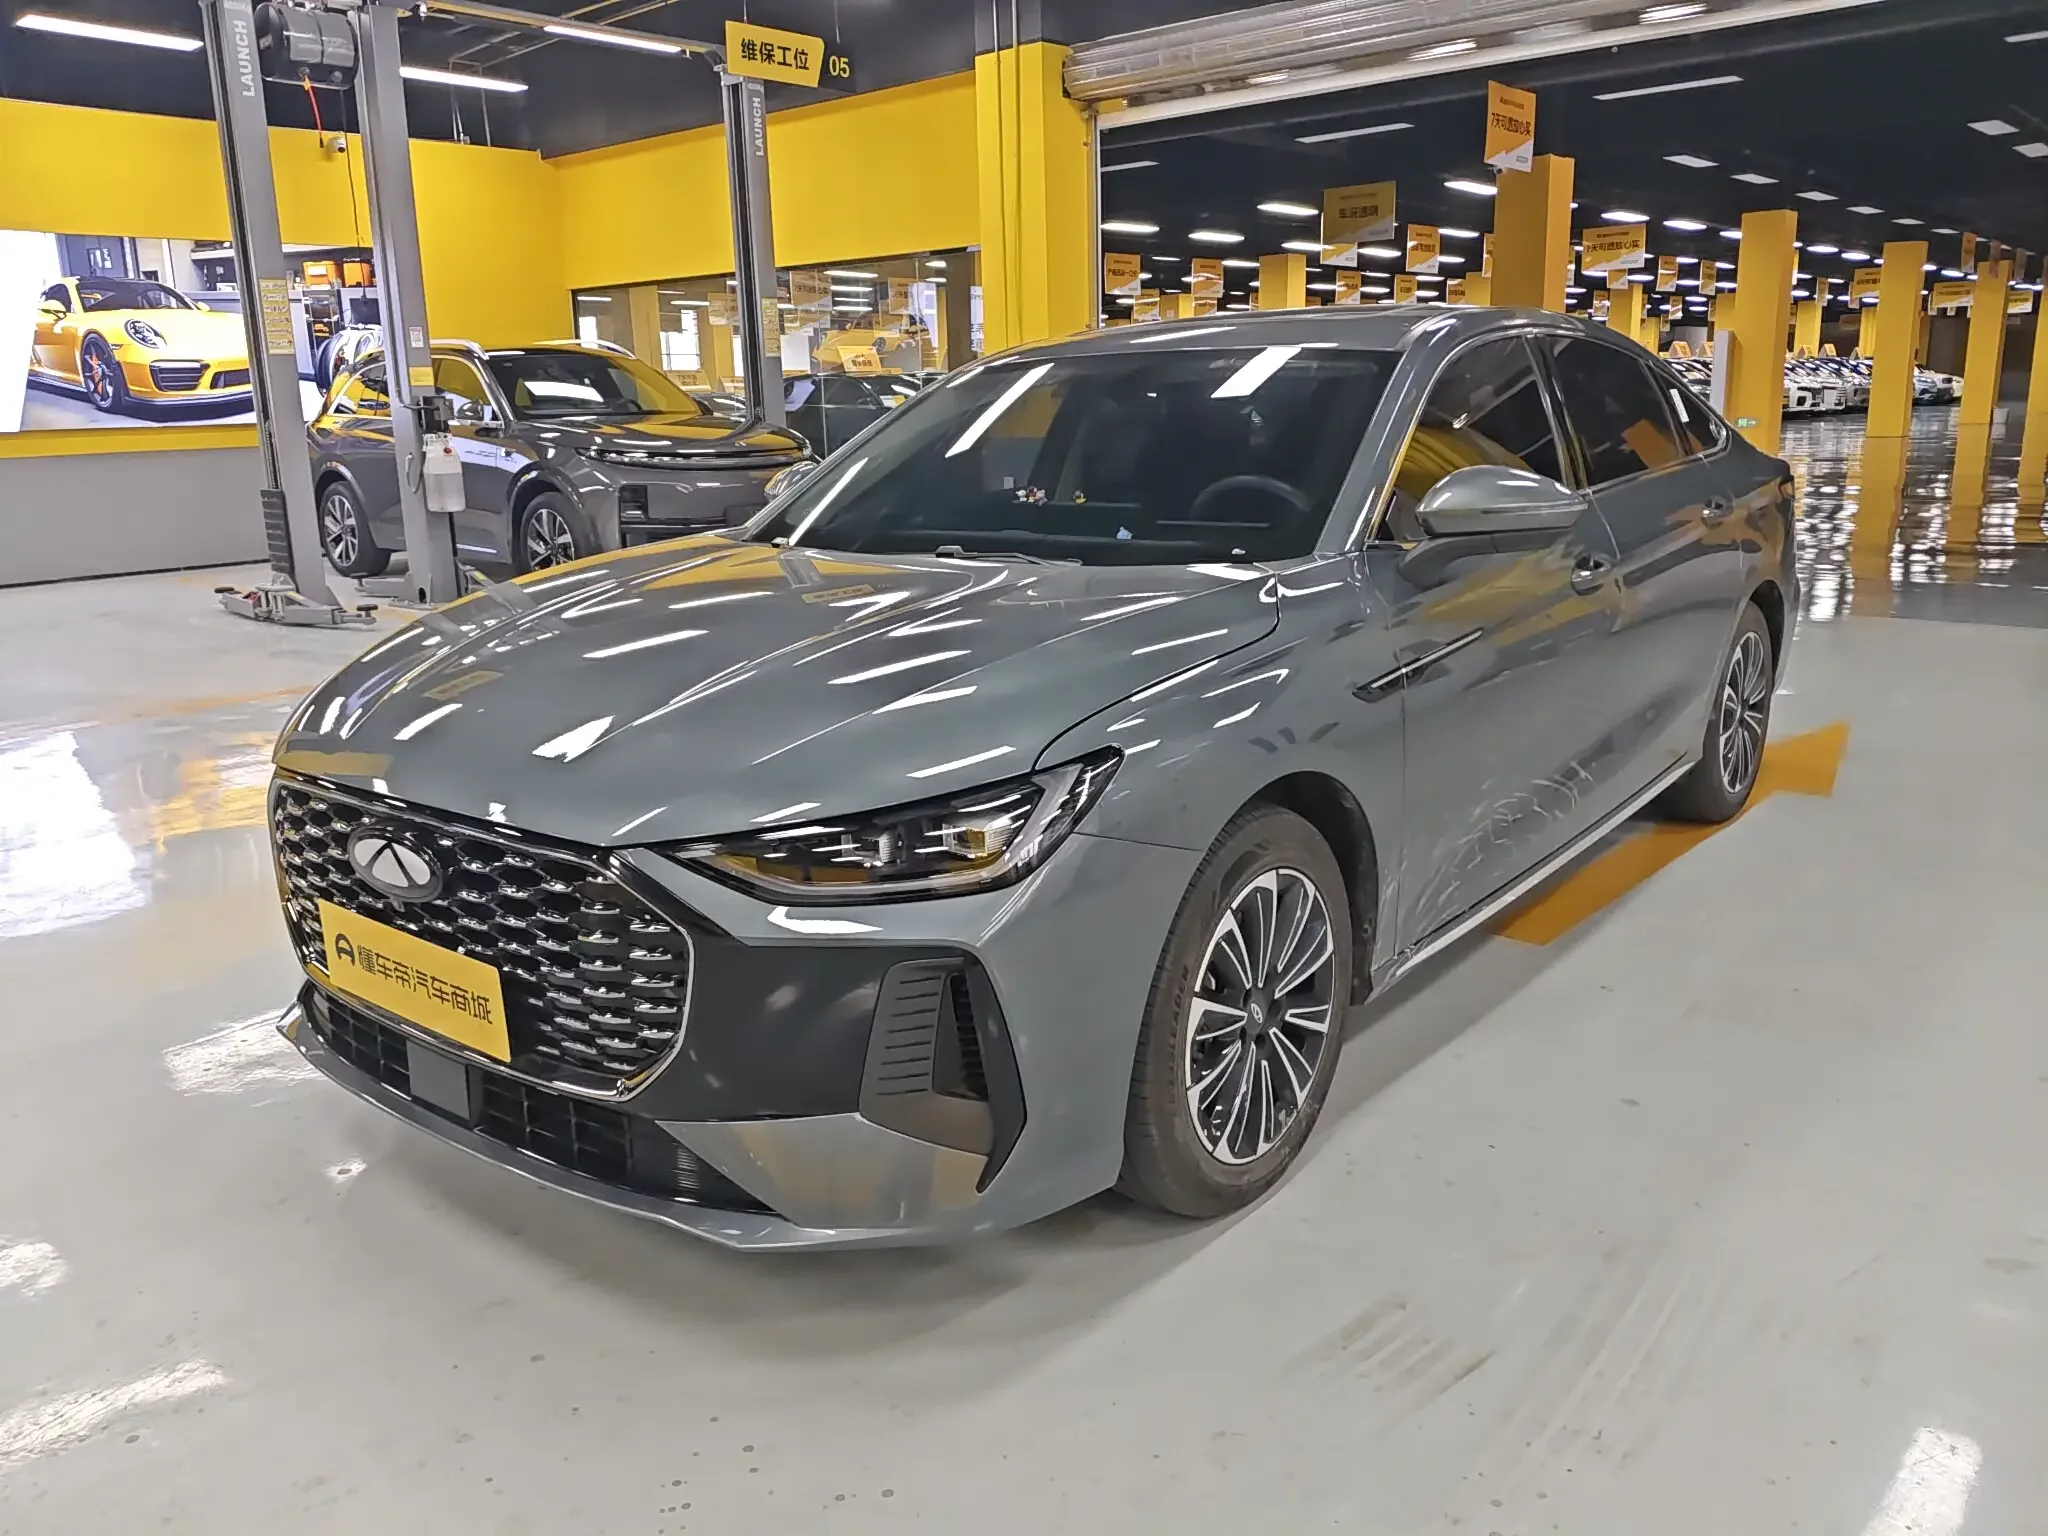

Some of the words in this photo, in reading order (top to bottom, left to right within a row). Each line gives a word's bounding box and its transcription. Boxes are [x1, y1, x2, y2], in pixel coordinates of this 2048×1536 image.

[233, 20, 256, 97] LAUNCH
[741, 38, 810, 71] 维保工位
[829, 55, 850, 78] 05
[752, 97, 765, 156] LAUNCH
[357, 944, 493, 1025] 懂车帝汽车商城
